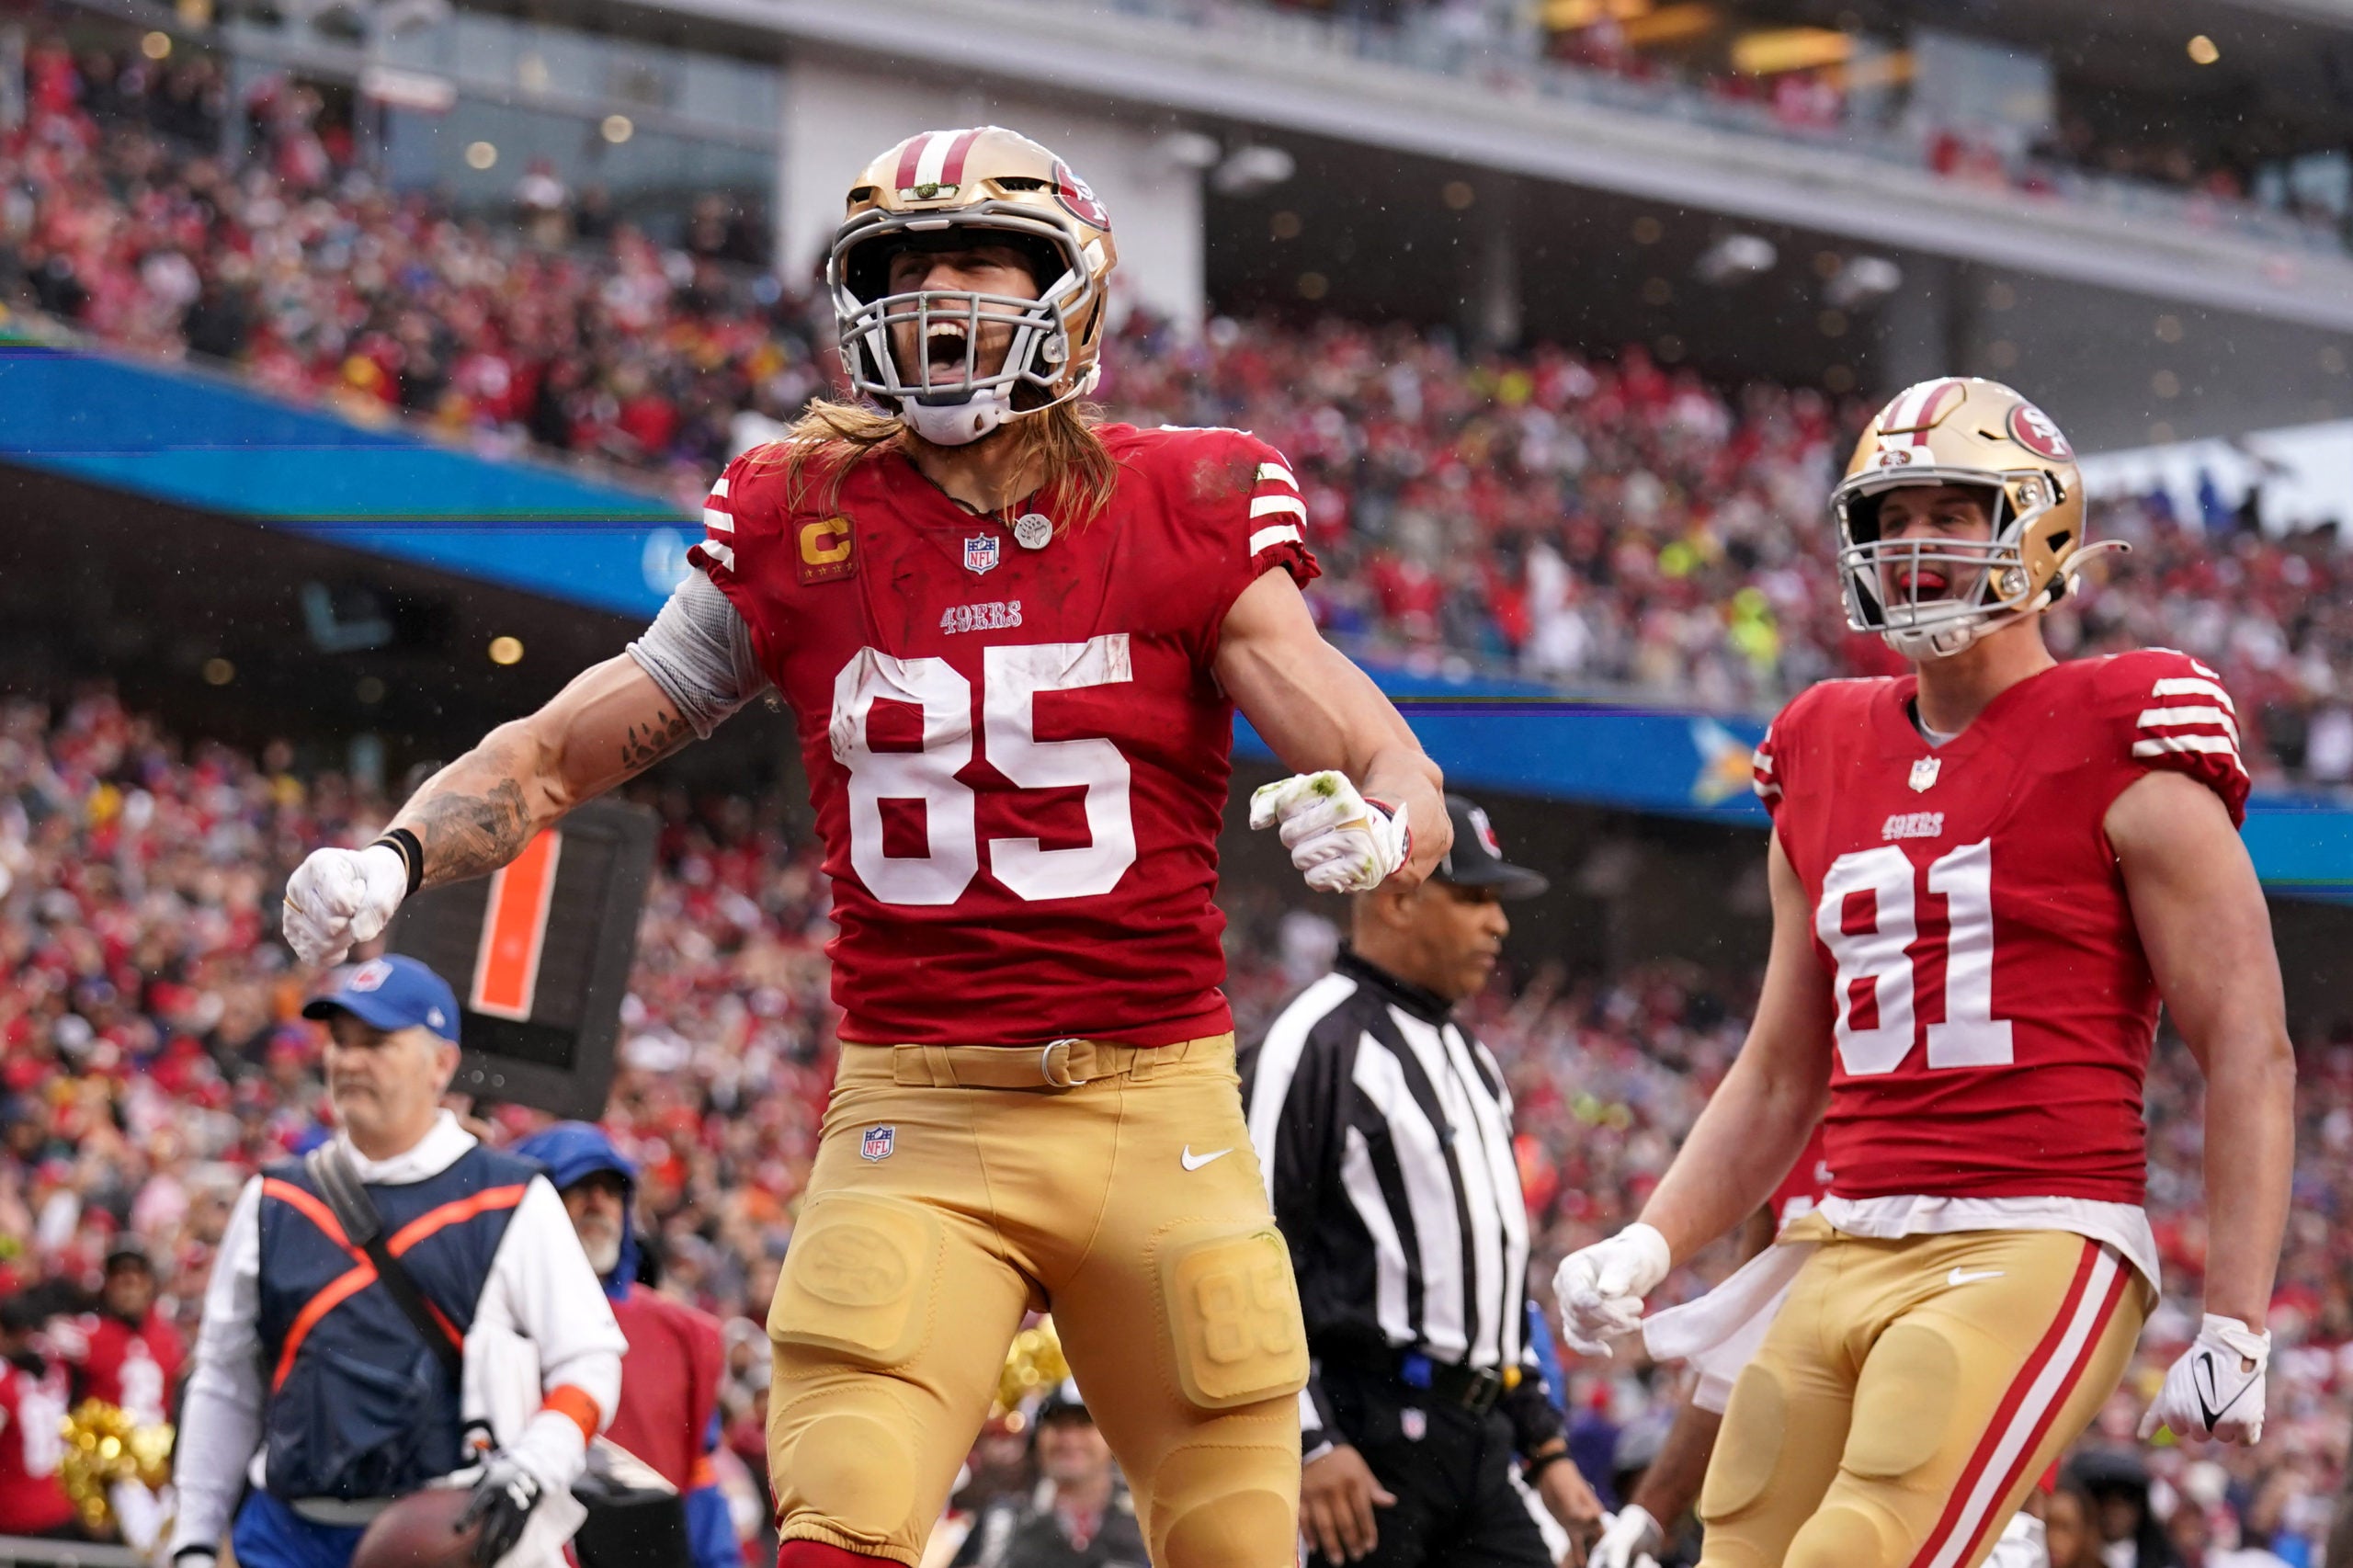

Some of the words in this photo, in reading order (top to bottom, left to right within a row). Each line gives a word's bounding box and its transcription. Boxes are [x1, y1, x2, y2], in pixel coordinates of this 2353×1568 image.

[801, 517, 851, 565] C
[970, 551, 993, 567] NFL
[939, 600, 1022, 635] 49ERS
[829, 633, 1136, 905] 85
[1816, 836, 2014, 1075] 81
[866, 1140, 888, 1155] NFL
